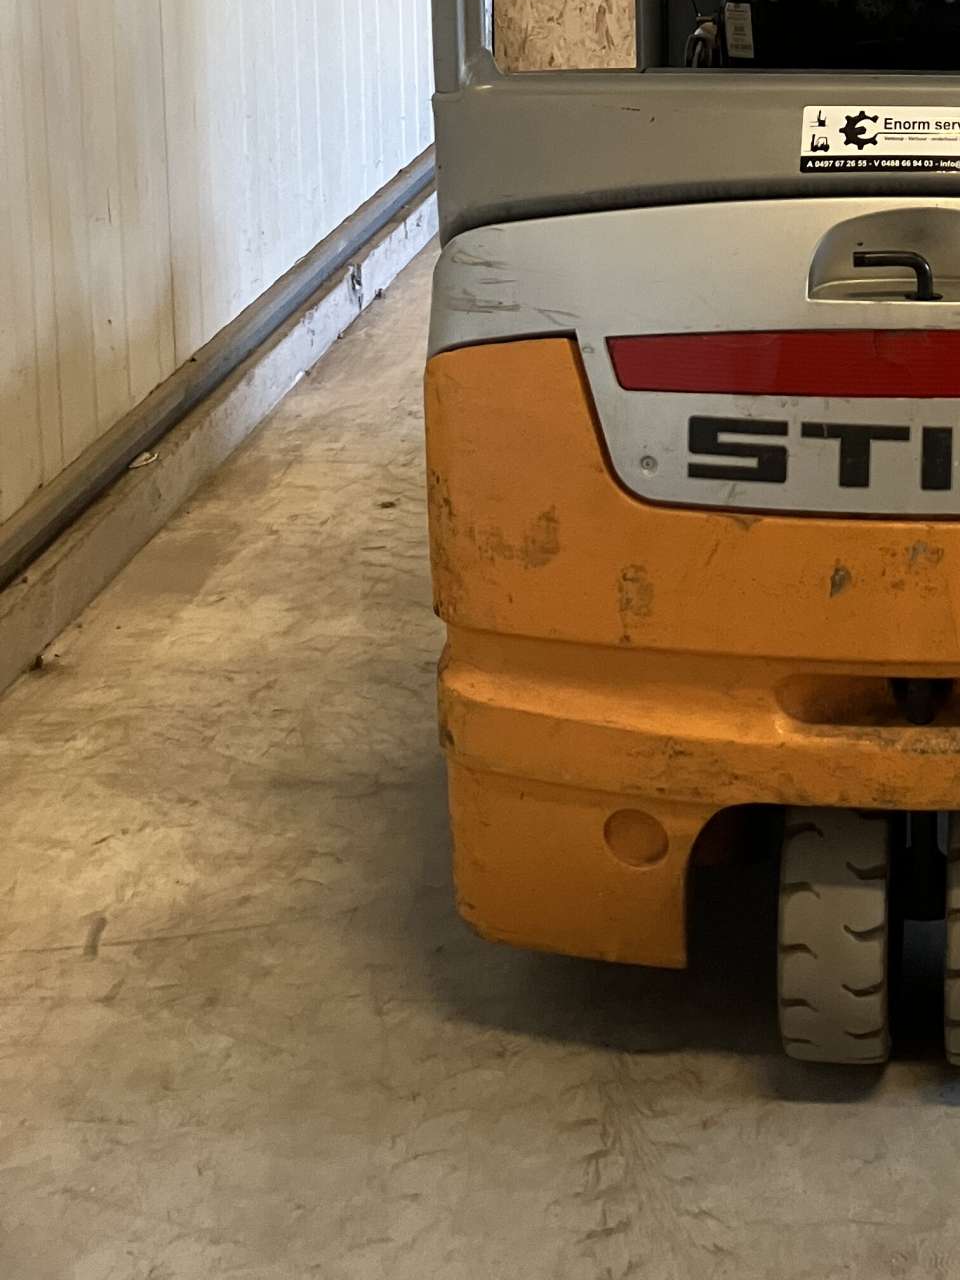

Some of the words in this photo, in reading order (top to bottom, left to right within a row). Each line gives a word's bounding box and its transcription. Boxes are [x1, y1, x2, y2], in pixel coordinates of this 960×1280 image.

[884, 117, 930, 130] Enorm
[806, 160, 814, 168] A
[815, 160, 834, 168] 0497
